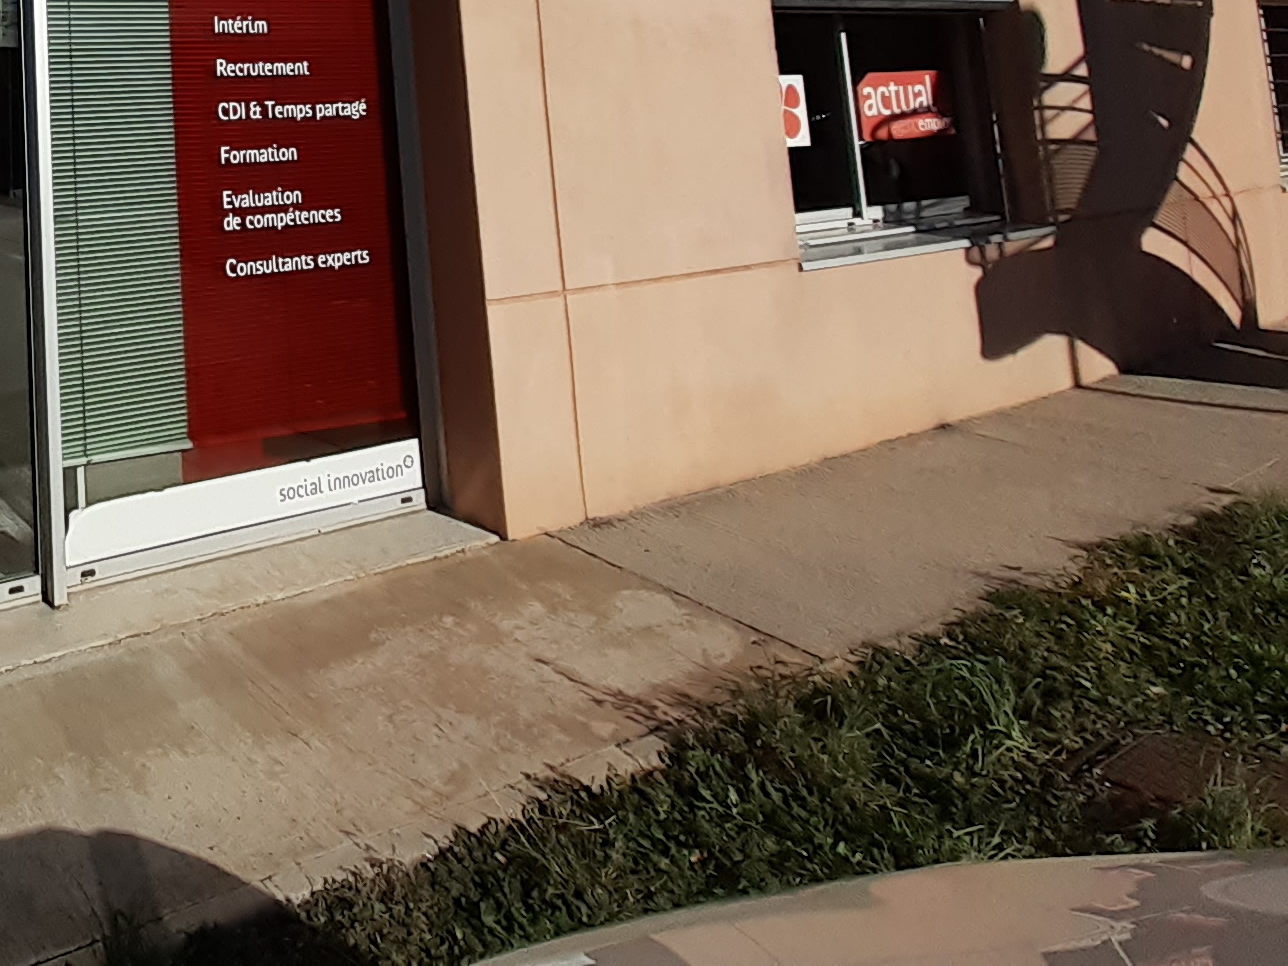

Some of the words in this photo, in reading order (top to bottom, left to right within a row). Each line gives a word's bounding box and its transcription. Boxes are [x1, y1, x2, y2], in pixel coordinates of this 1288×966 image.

[214, 15, 268, 34] Intérim
[215, 58, 310, 77] Recrutement
[863, 74, 938, 117] actual
[217, 101, 246, 120] CDI
[249, 101, 262, 119] &
[264, 100, 313, 122] Temps
[316, 97, 368, 121] partagé
[219, 143, 298, 165] Formation
[222, 187, 302, 209] Evaluation
[223, 212, 242, 231] de
[245, 207, 342, 230] compétences
[225, 254, 314, 277] Consultants
[317, 249, 370, 271] experts
[278, 476, 324, 503] social
[327, 462, 404, 494] innovation
